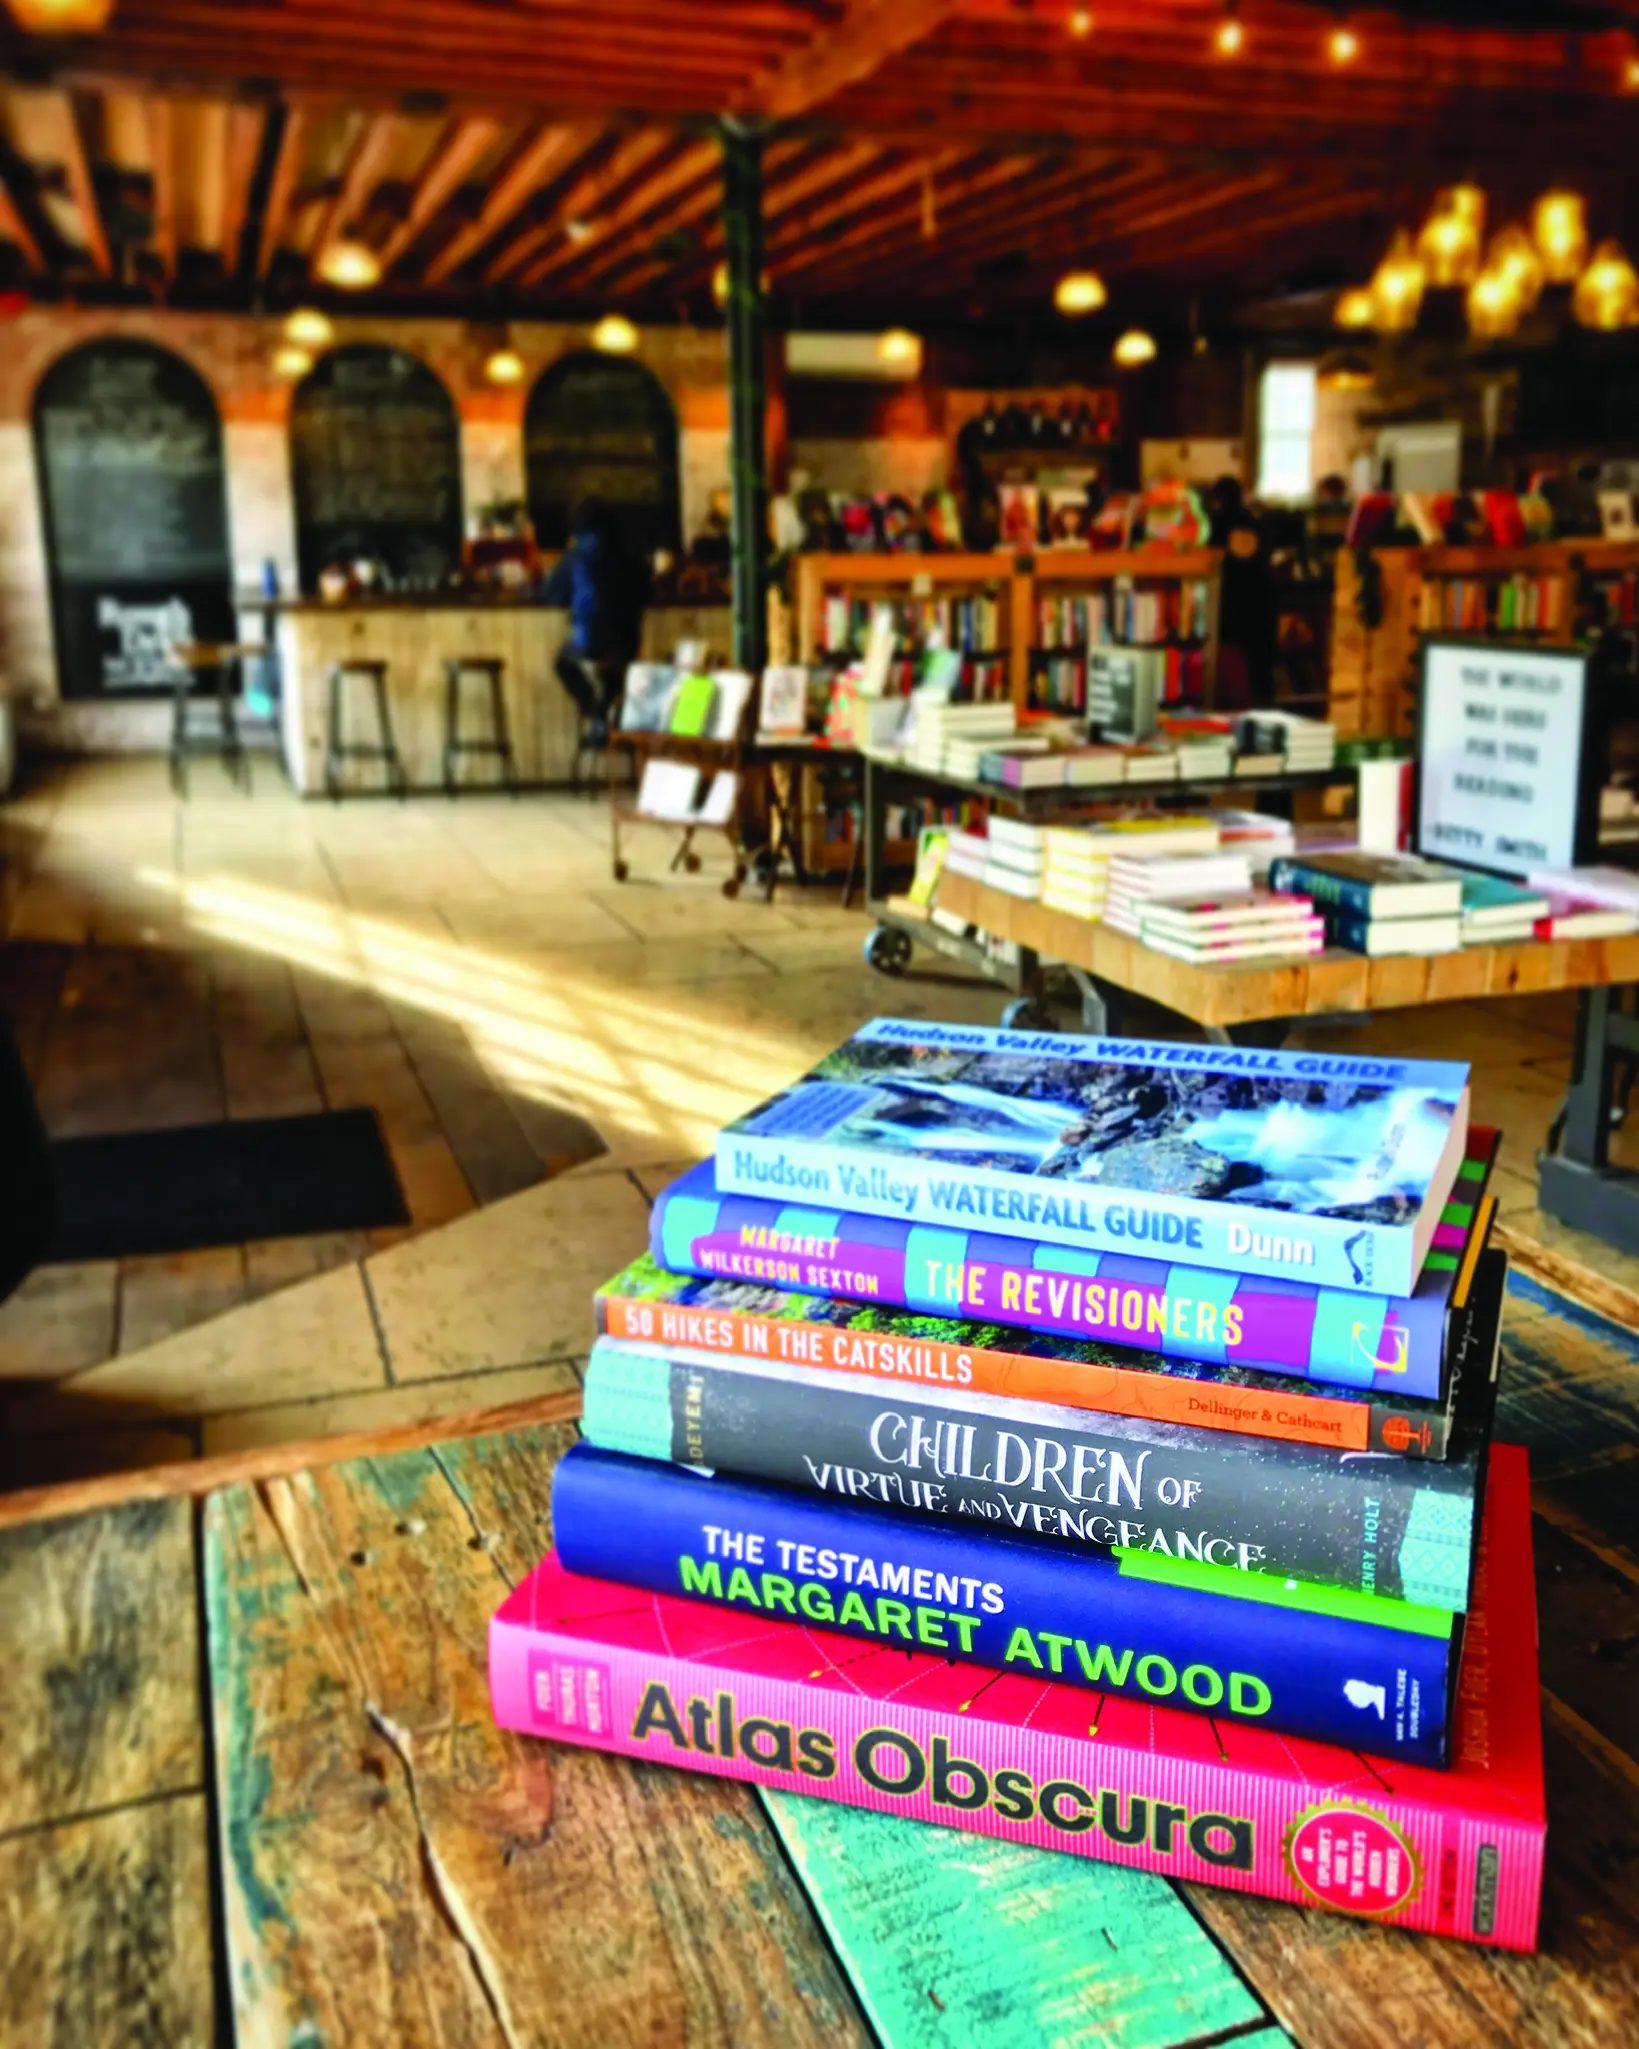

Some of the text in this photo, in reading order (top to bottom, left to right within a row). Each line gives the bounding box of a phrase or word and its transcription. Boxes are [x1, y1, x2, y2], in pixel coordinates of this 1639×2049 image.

[877, 1023, 1408, 1081] Hudson Valley WATERFALL GUIDE
[733, 1150, 1316, 1267] Hudson Valley WATERFALL GUIDE Dunn
[739, 1223, 841, 1261] MARGARET
[699, 1248, 879, 1296] WILKERSON SEXTON
[925, 1260, 1244, 1347] THE REVISIONERS
[624, 1308, 974, 1385] 50 HIKES IN THE CATSKILLS
[1188, 1396, 1257, 1424] Dellinger
[1276, 1410, 1343, 1435] Cathcart
[869, 1411, 1203, 1511] CHILDREN OF
[802, 1454, 1267, 1574] VIRTUE AND VENGEANCE
[1363, 1496, 1380, 1544] HOLT
[701, 1525, 1006, 1614] THE TESTAMENTS
[678, 1554, 1273, 1717] MARGARET ATWOOD
[629, 1678, 1256, 1873] Atlas Obscura
